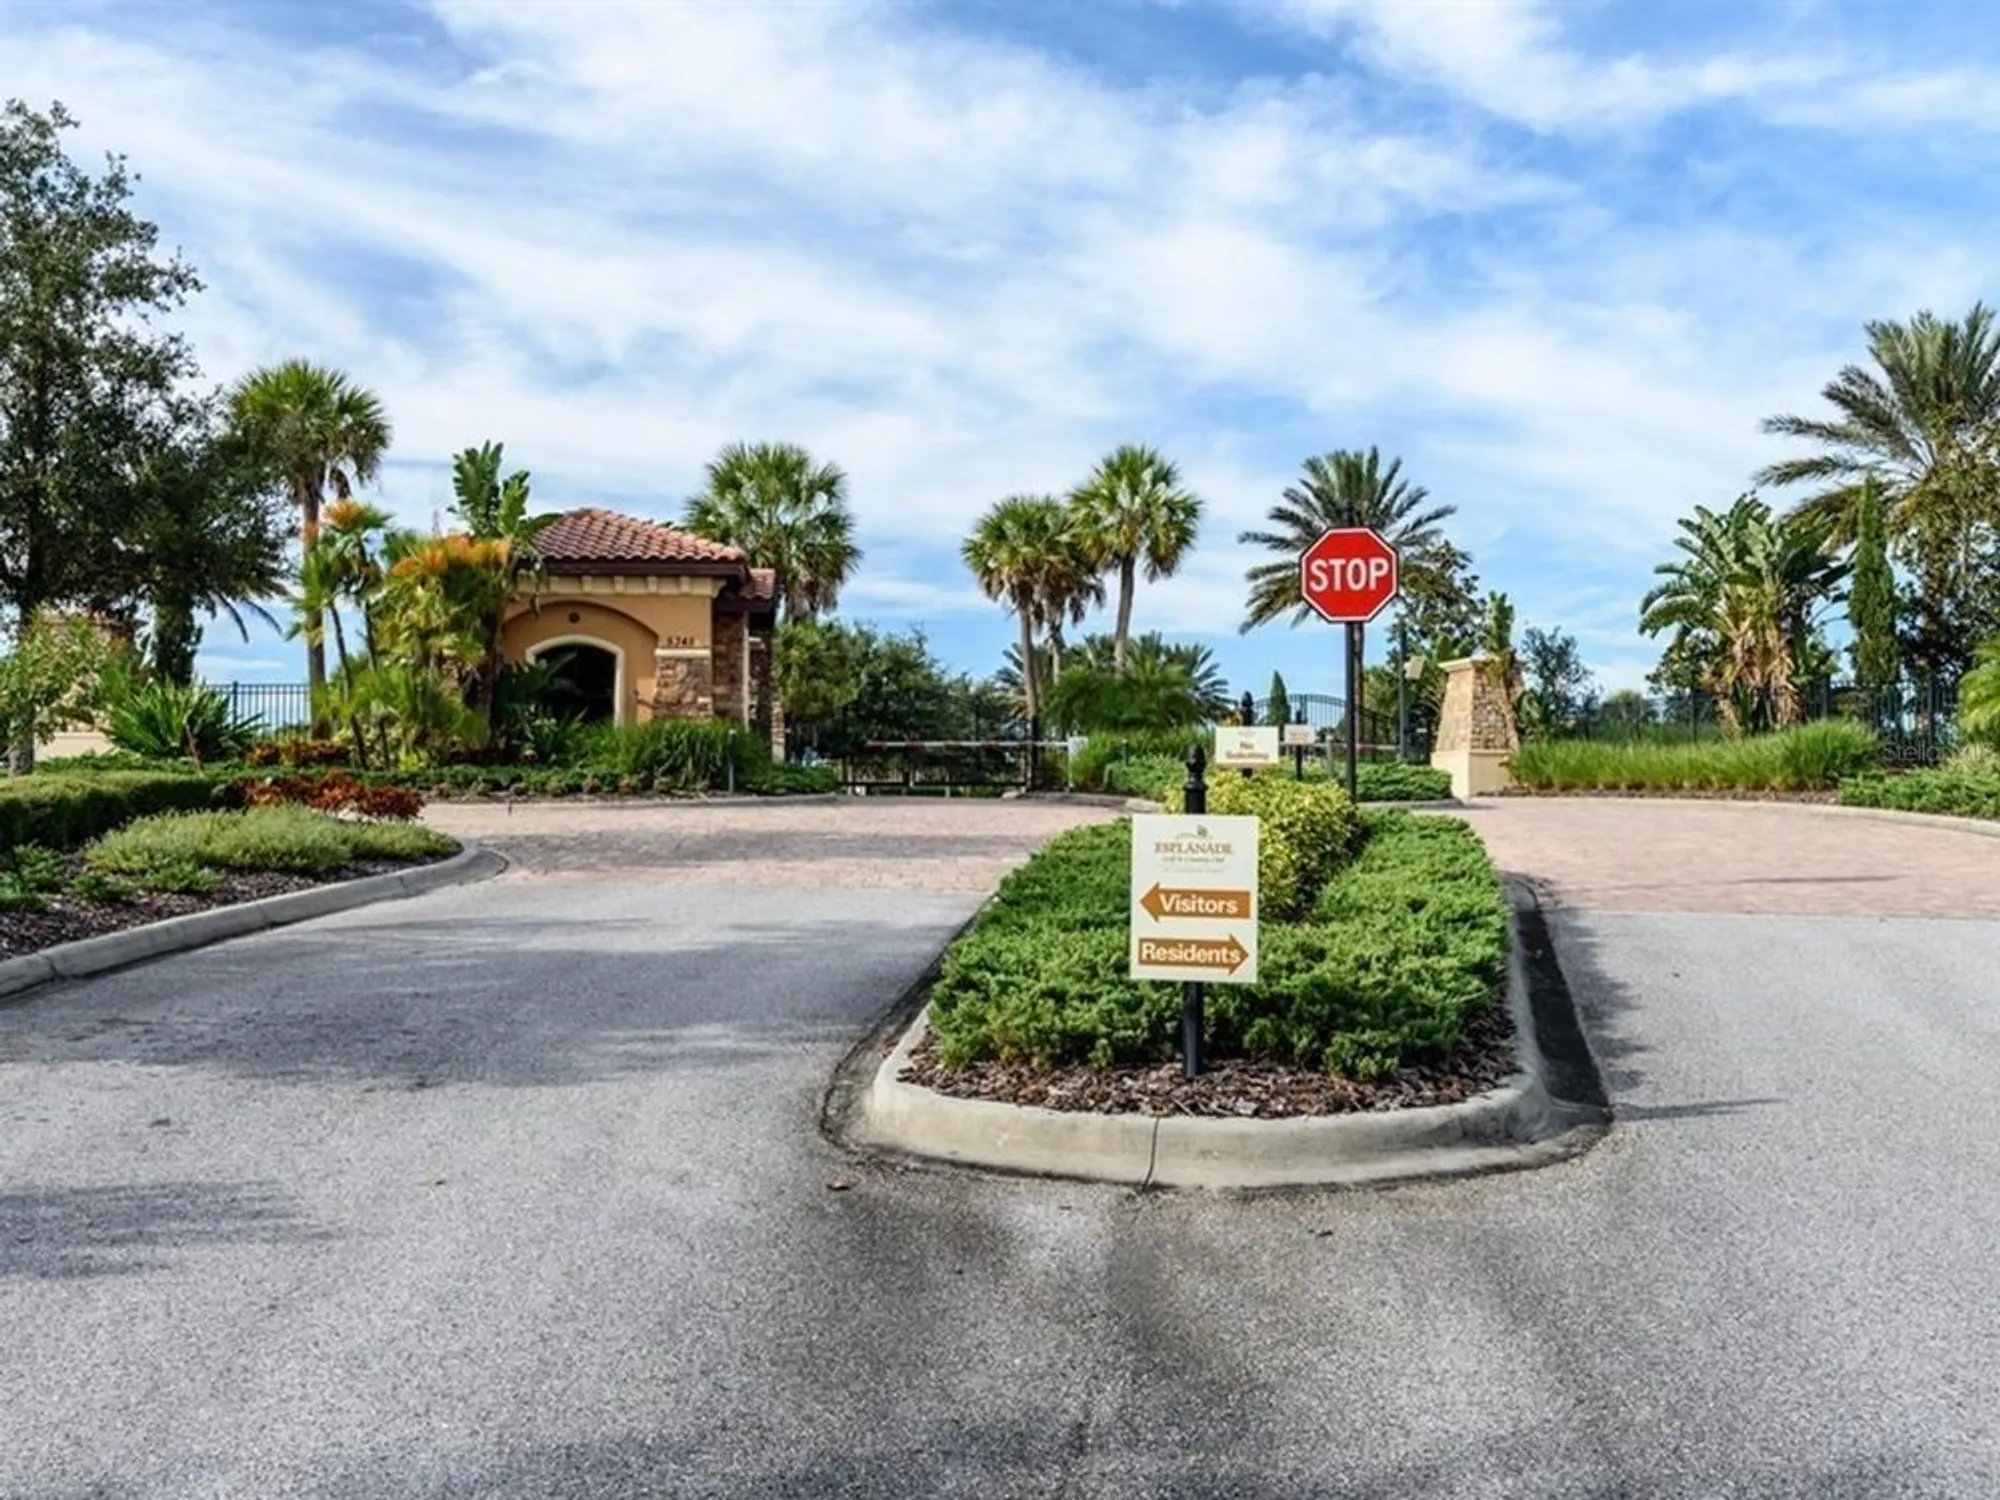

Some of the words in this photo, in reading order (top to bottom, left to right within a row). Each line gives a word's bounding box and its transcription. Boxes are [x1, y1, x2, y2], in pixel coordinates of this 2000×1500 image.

[1309, 557, 1389, 592] STOP
[1154, 842, 1232, 854] ESPLANADE
[1159, 893, 1238, 914] Visitors
[1141, 943, 1241, 964] Residents
